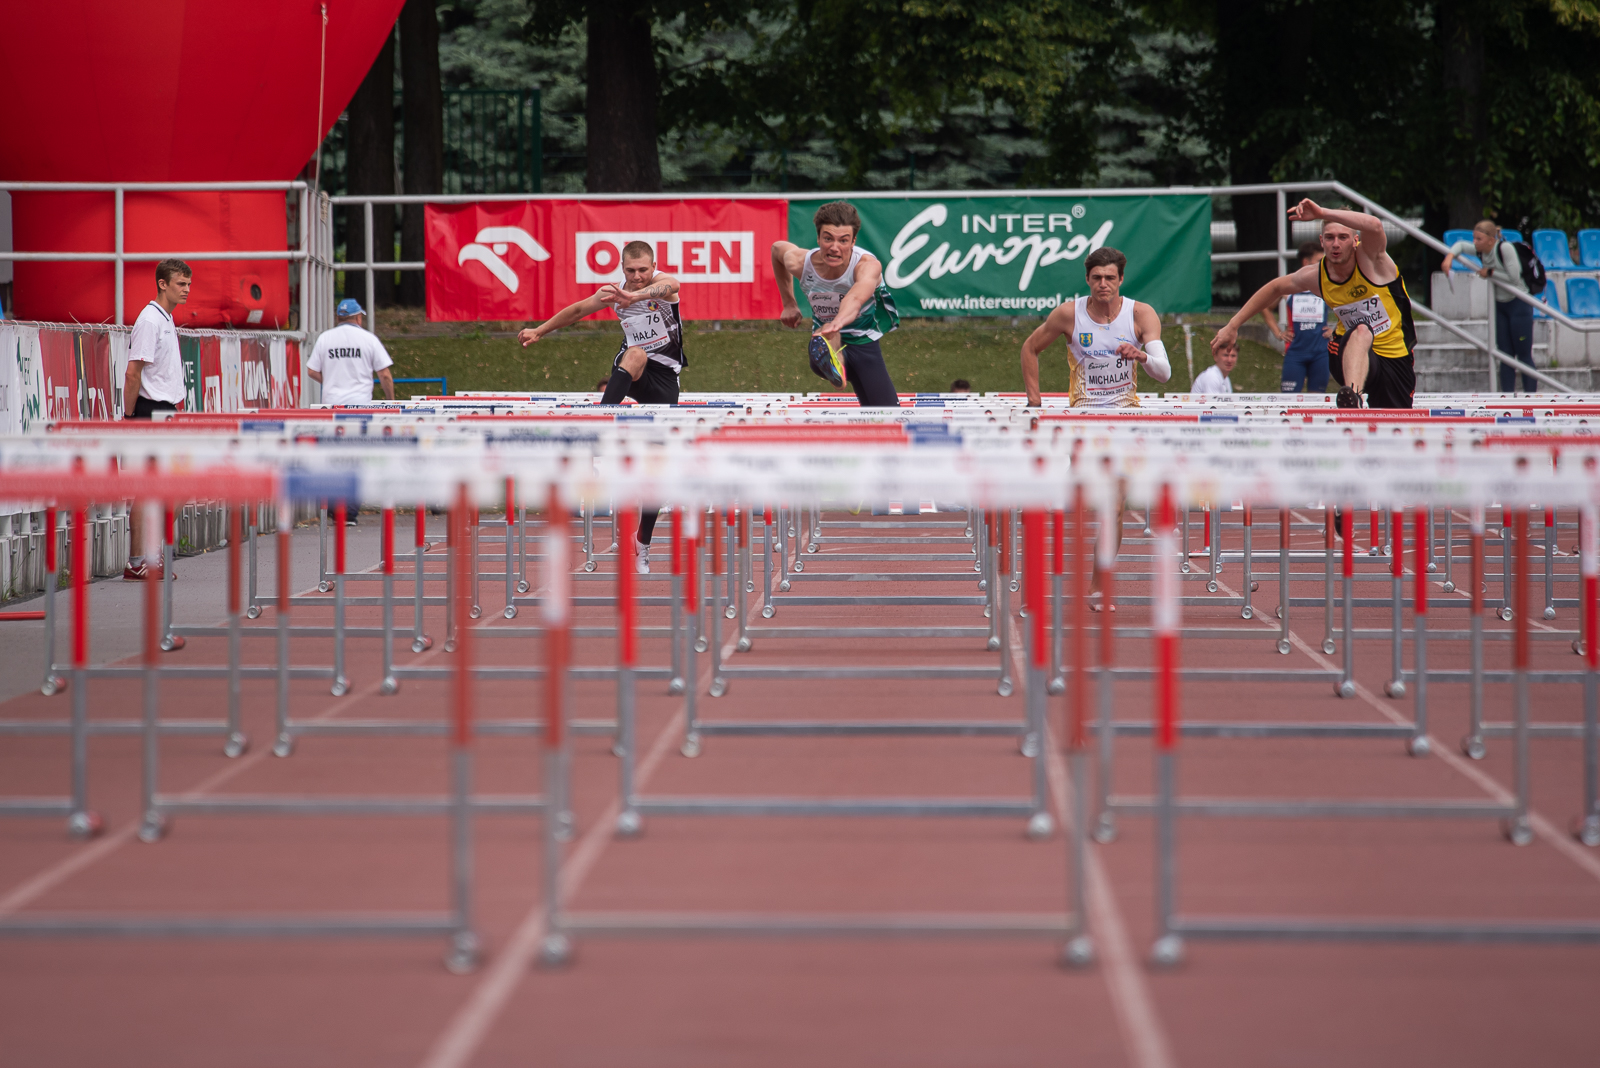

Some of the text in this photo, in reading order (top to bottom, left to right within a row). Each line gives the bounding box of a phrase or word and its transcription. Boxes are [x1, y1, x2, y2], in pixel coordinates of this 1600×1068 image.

[961, 214, 1073, 233] INTER
[885, 203, 1114, 291] Europol
[586, 240, 742, 275] OLEN
[919, 292, 1079, 311] www.intereuropol
[1363, 297, 1378, 311] 79
[645, 313, 661, 325] 76
[632, 328, 658, 342] HAŁA
[328, 347, 362, 361] SĘDZIA
[1116, 358, 1128, 368] 81
[1089, 371, 1129, 384] MICHALAK
